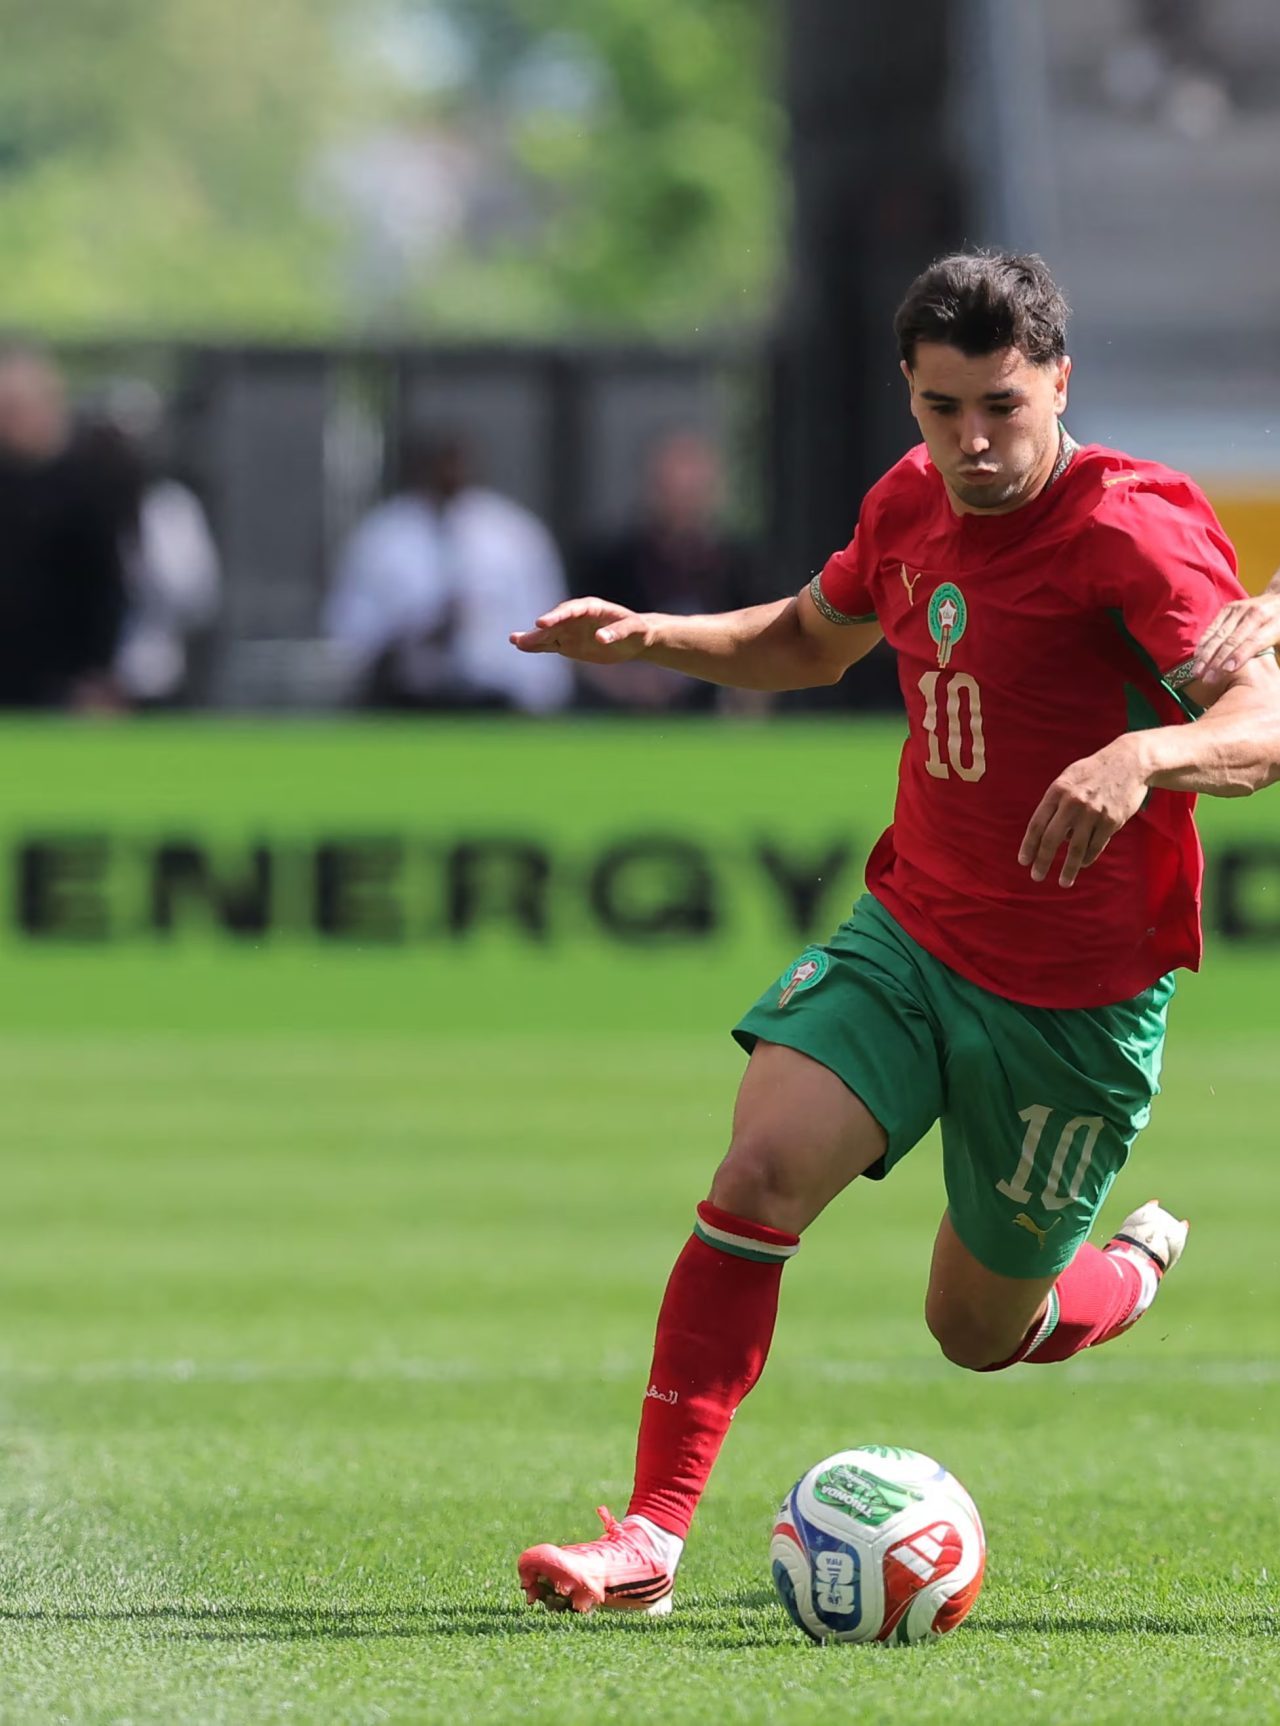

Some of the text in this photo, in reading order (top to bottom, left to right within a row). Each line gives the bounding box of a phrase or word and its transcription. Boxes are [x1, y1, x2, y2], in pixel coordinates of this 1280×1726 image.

[917, 670, 987, 783] 10
[18, 838, 858, 942] ENERGY
[995, 1103, 1105, 1211] 10
[821, 1484, 873, 1519] TRIONDA
